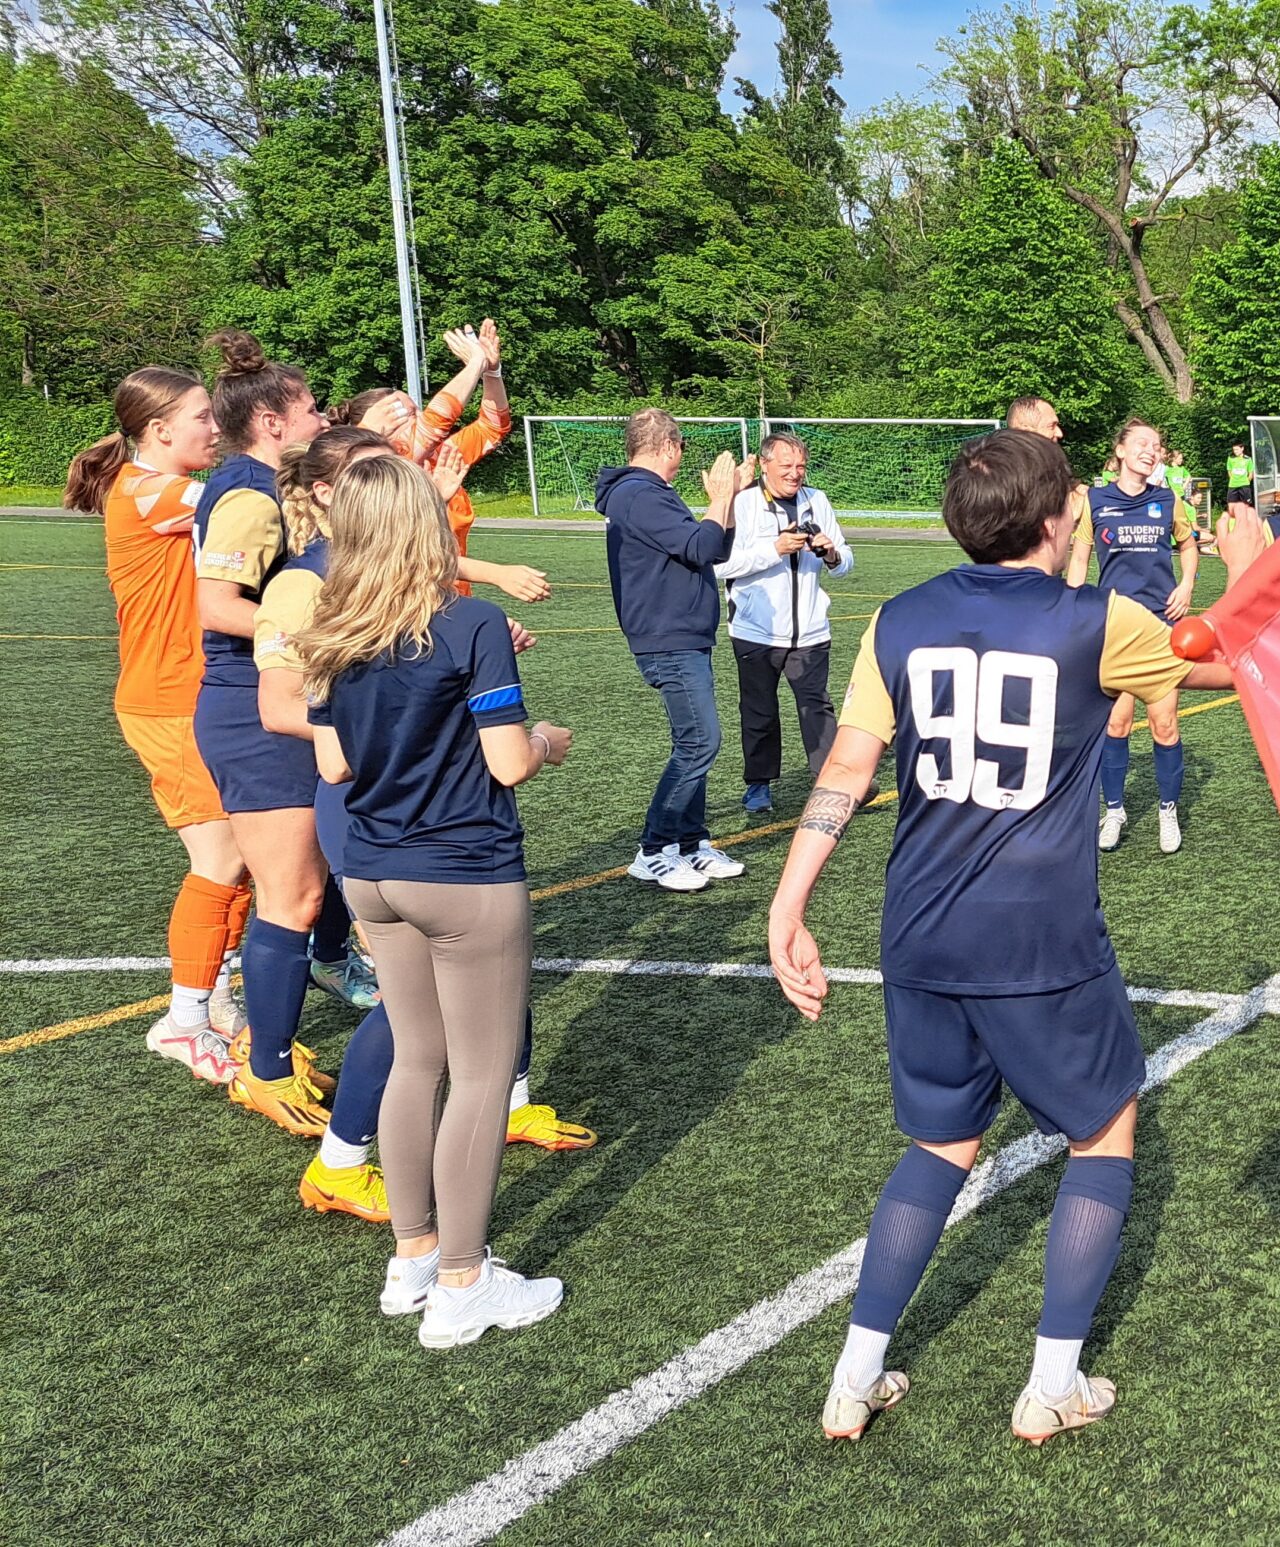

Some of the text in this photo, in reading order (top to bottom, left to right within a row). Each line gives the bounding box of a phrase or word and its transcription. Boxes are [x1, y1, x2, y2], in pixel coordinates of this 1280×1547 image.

[1118, 526, 1165, 535] STUDENTS
[1118, 535, 1159, 544] GO WEST
[907, 647, 1058, 810] 99
